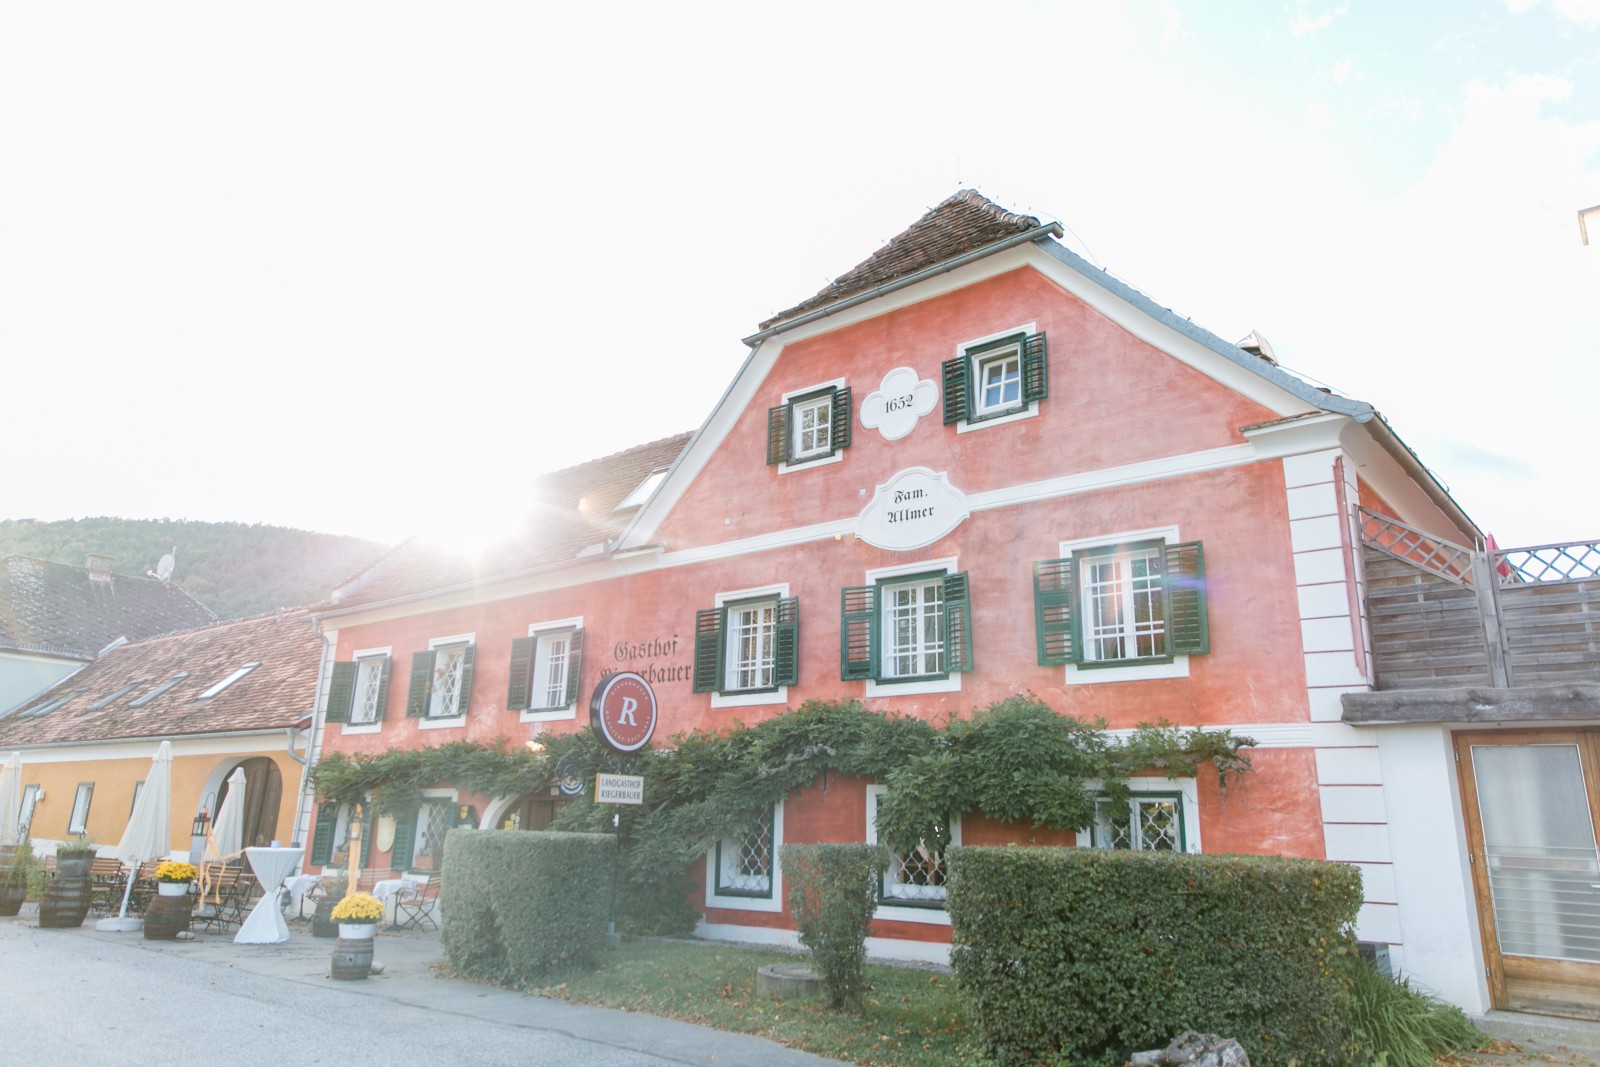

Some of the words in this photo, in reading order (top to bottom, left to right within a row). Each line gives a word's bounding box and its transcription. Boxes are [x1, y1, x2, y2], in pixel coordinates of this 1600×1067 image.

[884, 394, 914, 414] 1652
[894, 488, 928, 505] Fam.
[887, 506, 935, 524] Allmer
[614, 634, 679, 662] Gasthof
[600, 662, 692, 685] rbauer
[617, 696, 637, 727] R
[601, 777, 641, 789] LANDGASTHOF
[601, 789, 641, 800] RIEGERBAUER
